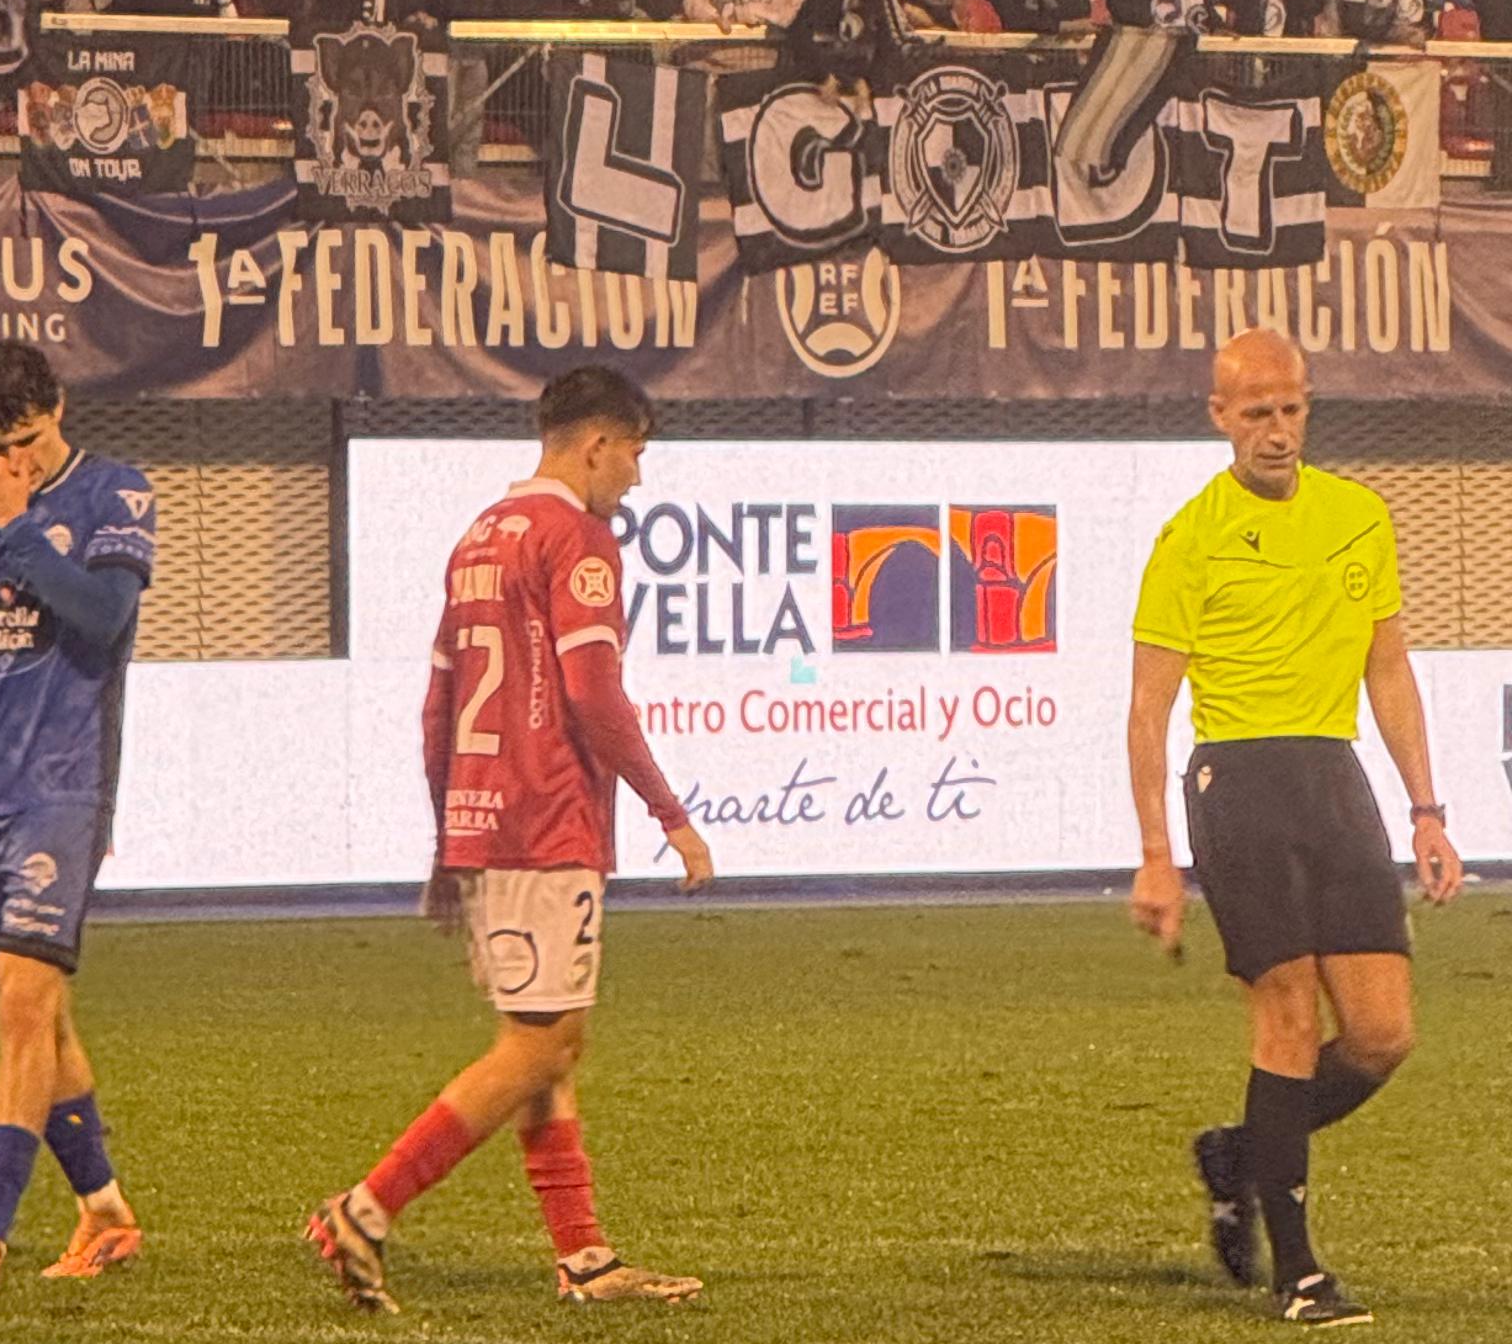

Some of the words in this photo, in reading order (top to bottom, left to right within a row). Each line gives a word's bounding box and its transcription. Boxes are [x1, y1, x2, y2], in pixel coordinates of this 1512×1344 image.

[67, 50, 91, 71] LA
[94, 50, 136, 72] MINA
[68, 158, 91, 179] ON
[93, 158, 143, 182] TOUR
[456, 625, 505, 756] 2
[638, 696, 725, 736] ntro
[740, 686, 926, 735] Comercial
[939, 694, 960, 742] y
[972, 685, 1057, 728] Ocio
[844, 766, 906, 826] de
[926, 755, 997, 823] ti
[575, 890, 595, 945] 2
